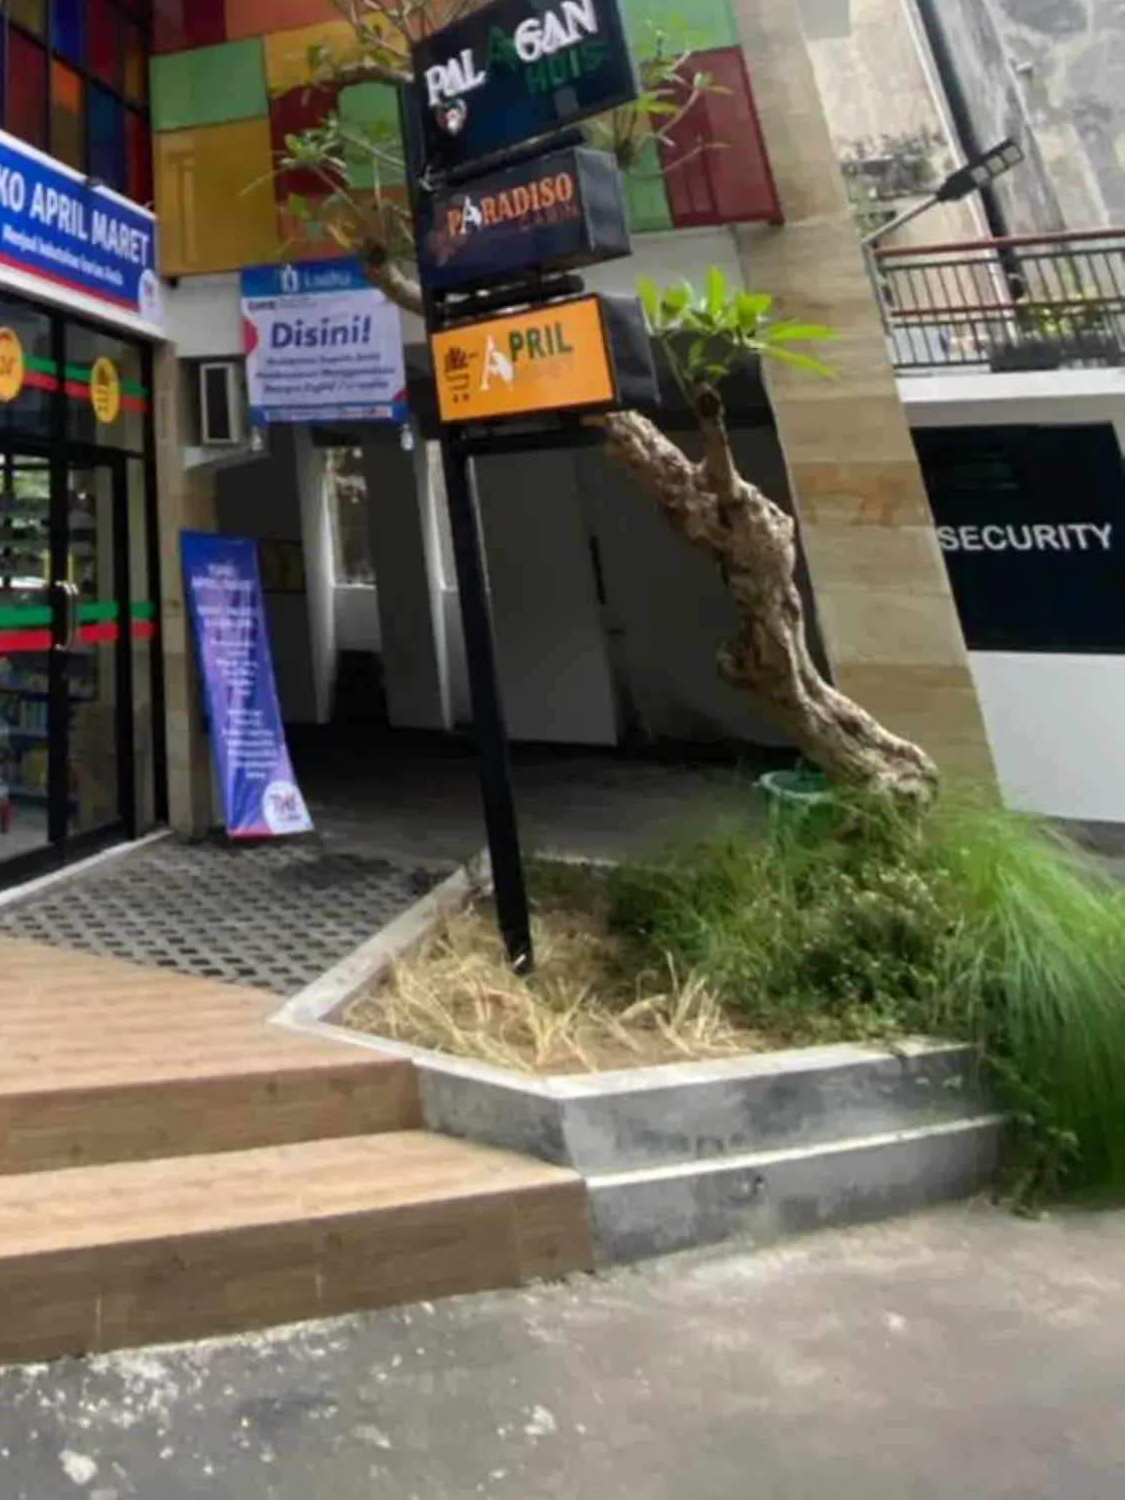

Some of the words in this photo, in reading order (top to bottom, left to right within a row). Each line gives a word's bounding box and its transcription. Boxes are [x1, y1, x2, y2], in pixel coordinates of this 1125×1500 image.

[29, 182, 88, 240] APRIL
[91, 211, 149, 266] MARET
[446, 172, 573, 236] PARADISO
[271, 315, 372, 349] Disini!
[479, 321, 573, 392] APRIL
[937, 522, 1112, 552] SECURITY
